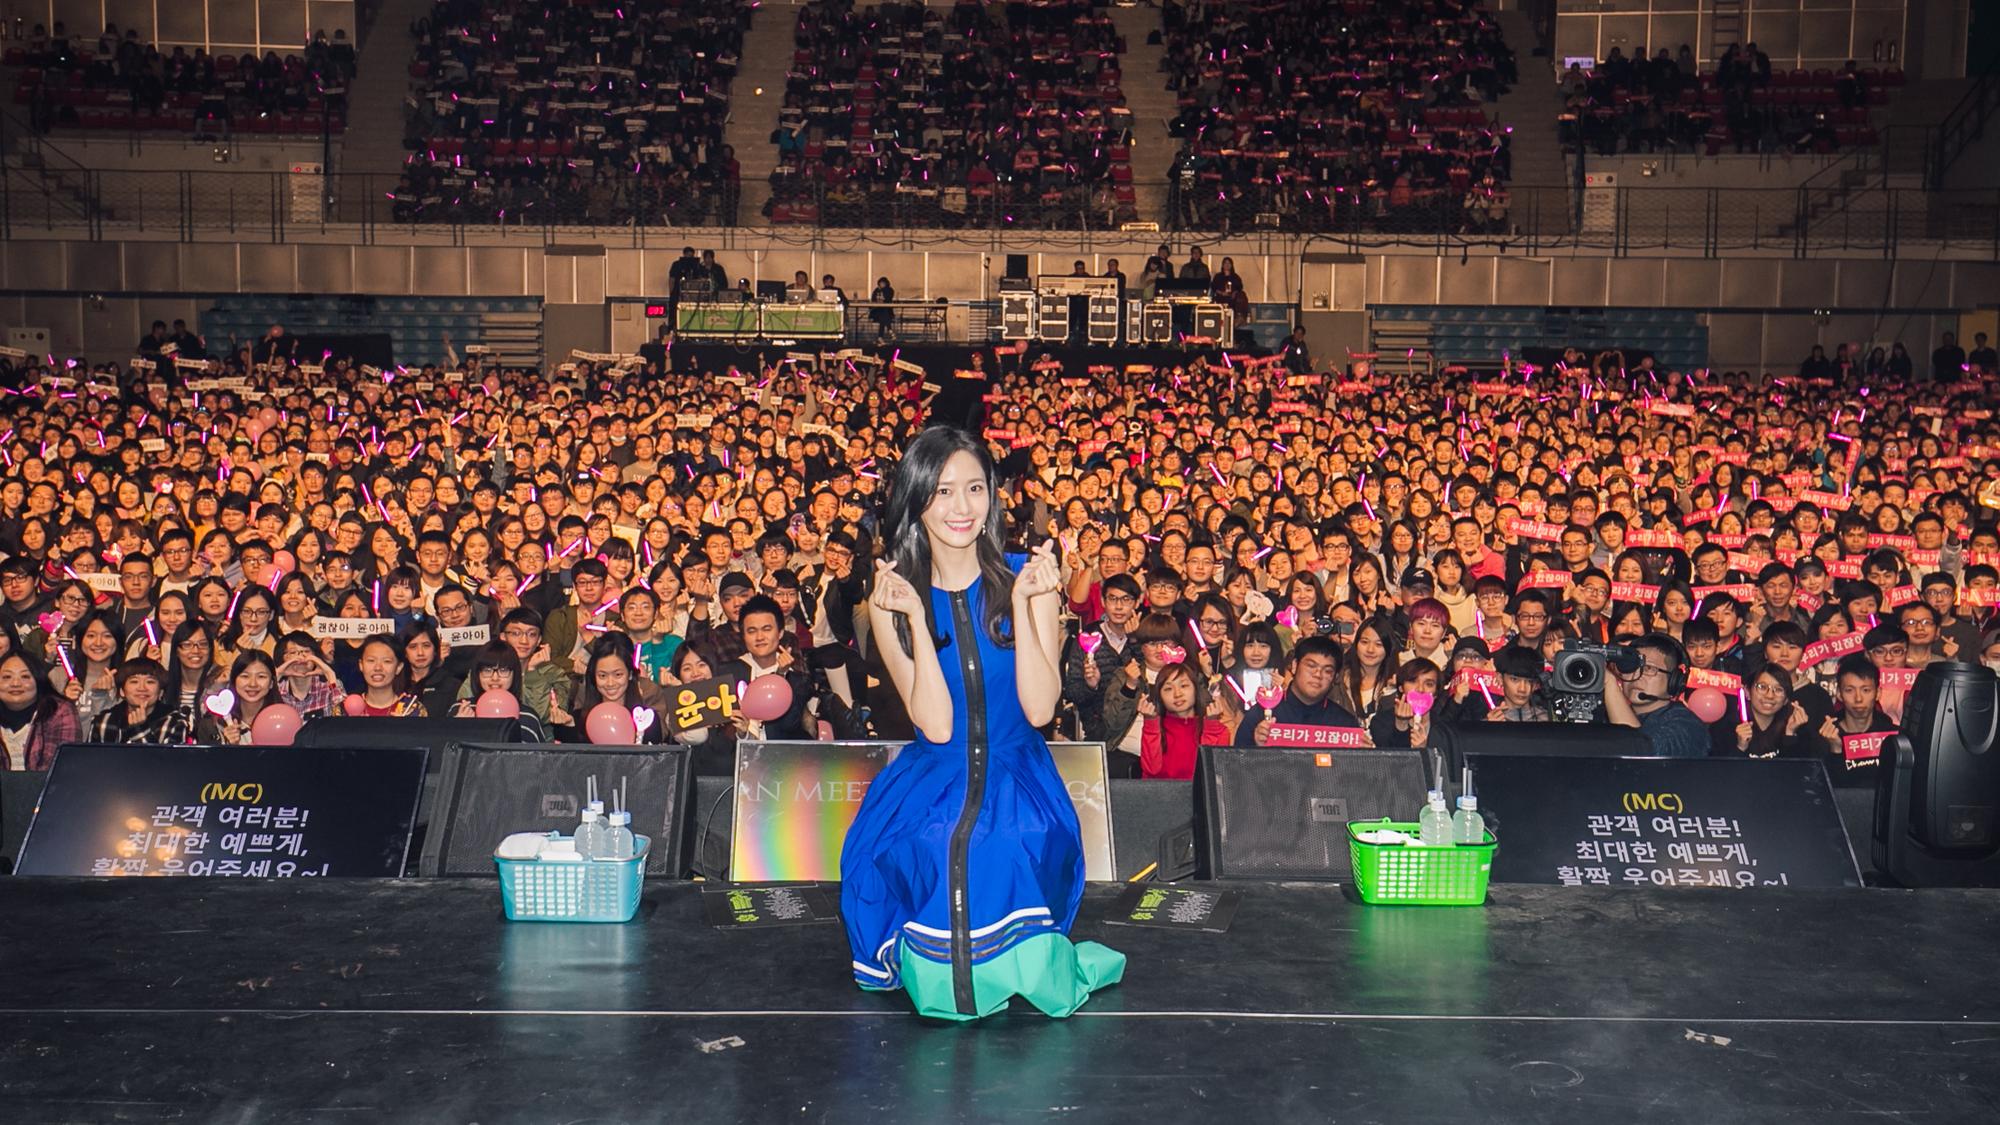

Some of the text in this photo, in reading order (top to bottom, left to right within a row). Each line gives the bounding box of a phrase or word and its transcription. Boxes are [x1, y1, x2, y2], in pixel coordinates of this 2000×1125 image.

[318, 623, 390, 634] 괜찮아 윤아야
[451, 630, 485, 642] 윤아야
[675, 684, 737, 728] 윤아
[1269, 727, 1360, 745] 우리가 있잖아!
[200, 782, 264, 804] (MC)
[1623, 792, 1684, 813] (MC)
[151, 804, 310, 829] 관객 여러분!
[1318, 804, 1341, 816] JBL
[1587, 814, 1742, 839] 관객 여러분!
[123, 832, 309, 857] 최대한 예쁘게,
[1576, 840, 1758, 867] 최대한 예쁘게,
[1557, 866, 1611, 888] 활짝
